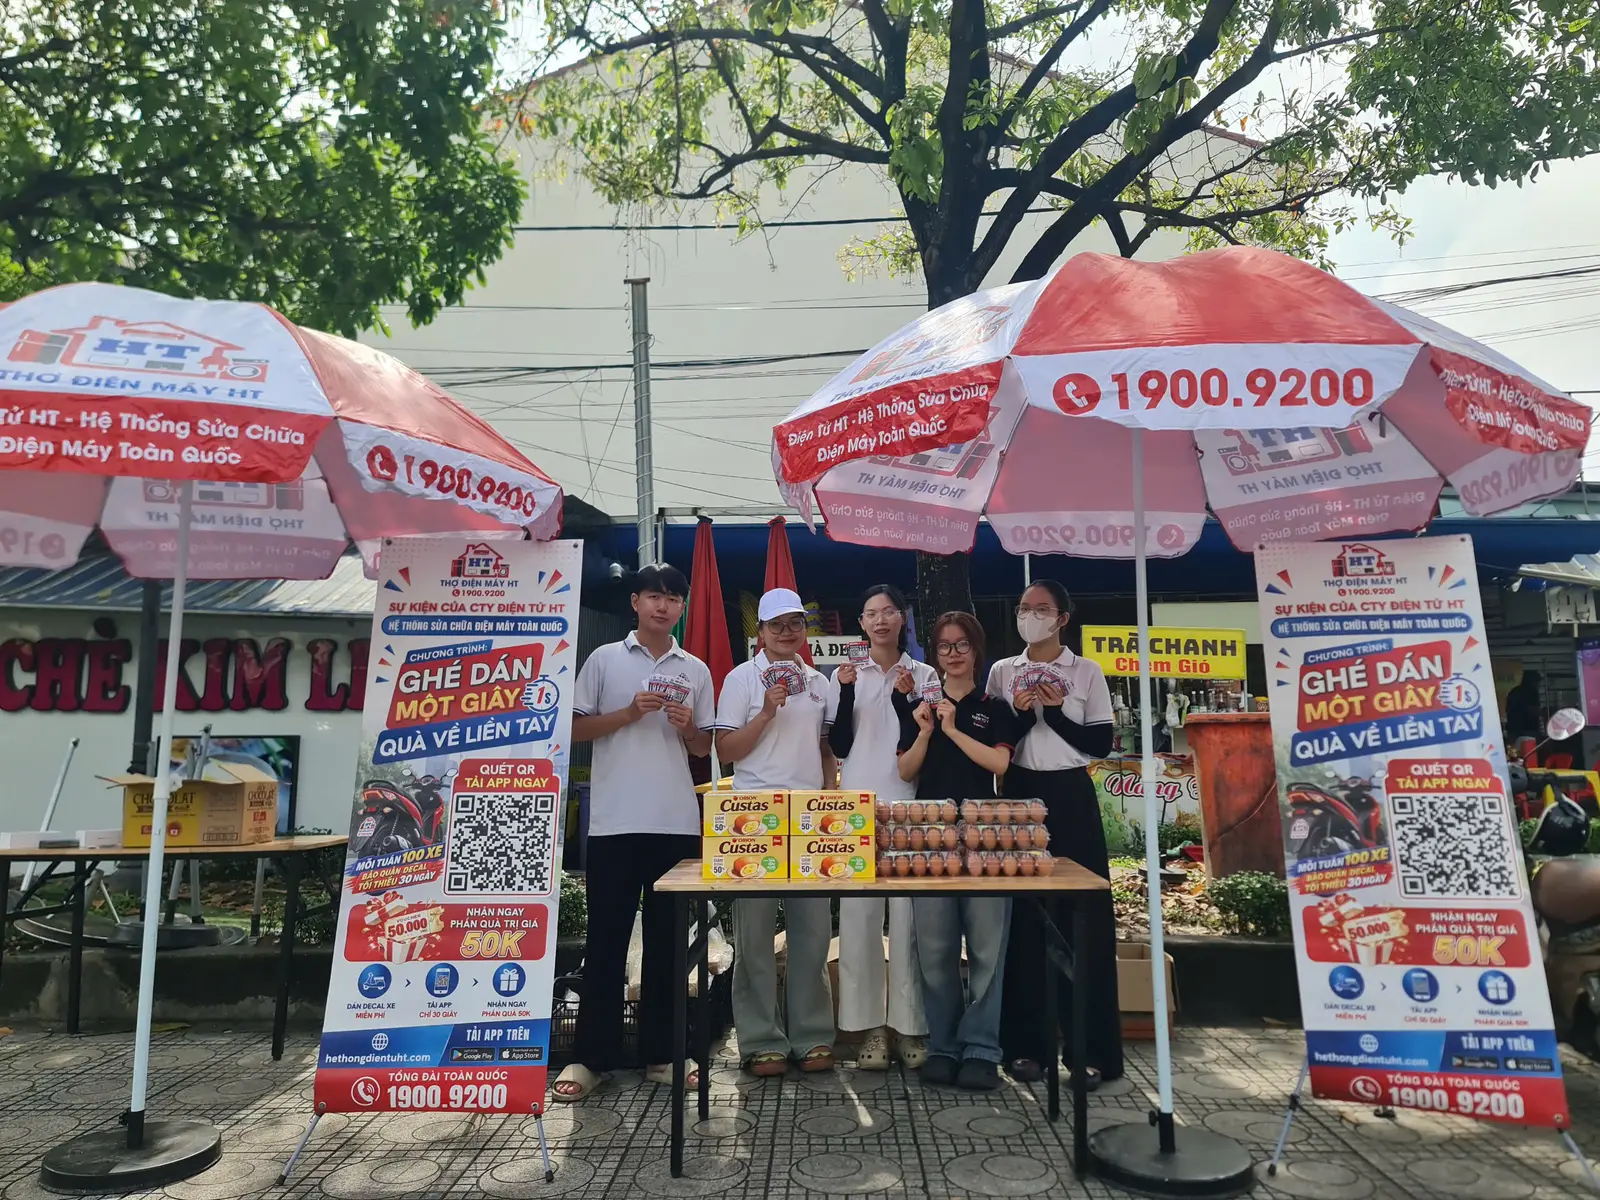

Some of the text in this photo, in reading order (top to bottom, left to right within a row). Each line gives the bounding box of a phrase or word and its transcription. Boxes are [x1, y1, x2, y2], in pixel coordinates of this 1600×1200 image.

[93, 337, 200, 359] HT
[227, 388, 263, 400] HT
[1111, 367, 1374, 410] 1900.9200
[788, 429, 814, 446] Điện
[817, 422, 831, 436] Tử
[833, 418, 849, 433] HT
[858, 406, 874, 424] Hệ
[877, 396, 917, 418] Thống
[918, 386, 946, 409] Sửa
[950, 382, 989, 401] Chữa
[30, 409, 60, 426] HT
[80, 411, 112, 433] Hệ
[120, 412, 190, 439] Thống
[197, 418, 238, 438] Sửa
[245, 426, 304, 445] Chữa
[817, 414, 948, 463] Điện Máy Toàn Quốc
[62, 439, 113, 462] Máy
[119, 441, 174, 462] Toàn
[181, 445, 242, 465] Quốc
[404, 455, 536, 517] 1900.9200
[468, 558, 493, 568] HT
[1348, 556, 1376, 567] HT
[440, 579, 460, 588] THỢ
[461, 578, 482, 588] ĐIỆN
[484, 578, 505, 588] MÁY
[389, 601, 565, 614] SỰ KIỆN CỦA CTY ĐIỆN TỬ HT
[1276, 602, 1294, 616] SỰ
[1297, 601, 1326, 615] KIỆN
[1330, 600, 1357, 613] CỦA
[1361, 602, 1386, 612] CTY
[1390, 599, 1421, 613] ĐIỆN
[1447, 600, 1465, 610] HT
[388, 619, 563, 632] HỆ THỐNG SỬA CHỮA ĐIỆN MÁY TOÀN QUỐC
[410, 644, 488, 662] CHƯƠNG TRÌNH:
[1149, 638, 1236, 656] CHANH
[1307, 642, 1390, 664] CHƯƠNG TRÌNH:
[0, 617, 132, 712] CHÈ
[153, 637, 293, 712] KIM
[1178, 659, 1210, 674] Gió
[399, 654, 534, 694] GHÉ DÁN
[1302, 652, 1444, 696] GHÉ DÁN
[396, 686, 521, 722] MỘT GIÂY
[1304, 684, 1436, 725] MỘT GIÂY
[380, 714, 555, 757] QUÀ VỀ LIỀN TAY
[1294, 711, 1481, 760] QUÀ VỀ LIỀN TAY
[480, 764, 536, 776] QUÉT QR
[1410, 762, 1474, 776] QUÉT QR
[464, 776, 549, 788] TẢI APP NGAY
[1421, 778, 1448, 789] APP
[1451, 777, 1492, 789] NGAY
[720, 800, 768, 812] Custas
[806, 798, 855, 812] Custas
[402, 848, 426, 864] 100
[426, 845, 444, 859] XE
[718, 842, 768, 854] Custas
[806, 840, 855, 854] Custas
[402, 864, 428, 874] DECAL
[398, 874, 412, 885] 30
[412, 871, 436, 882] NGÀY
[466, 907, 525, 917] NHẬN NGAY
[1466, 913, 1498, 922] NGAY
[388, 918, 428, 938] 50.000
[504, 920, 519, 929] TRỊ
[522, 918, 539, 928] GIÁ
[1348, 921, 1390, 940] 50.000
[460, 931, 526, 958] 50K
[1432, 935, 1507, 965] 50K
[466, 1026, 530, 1042] TẢI APP TRÊN
[325, 1052, 431, 1066] hethongdientuht.com
[388, 1068, 509, 1082] TỔNG ĐÀI TOÀN QUỐC
[387, 1084, 508, 1108] 1900.9200
[1388, 1087, 1524, 1118] 1900.9200
